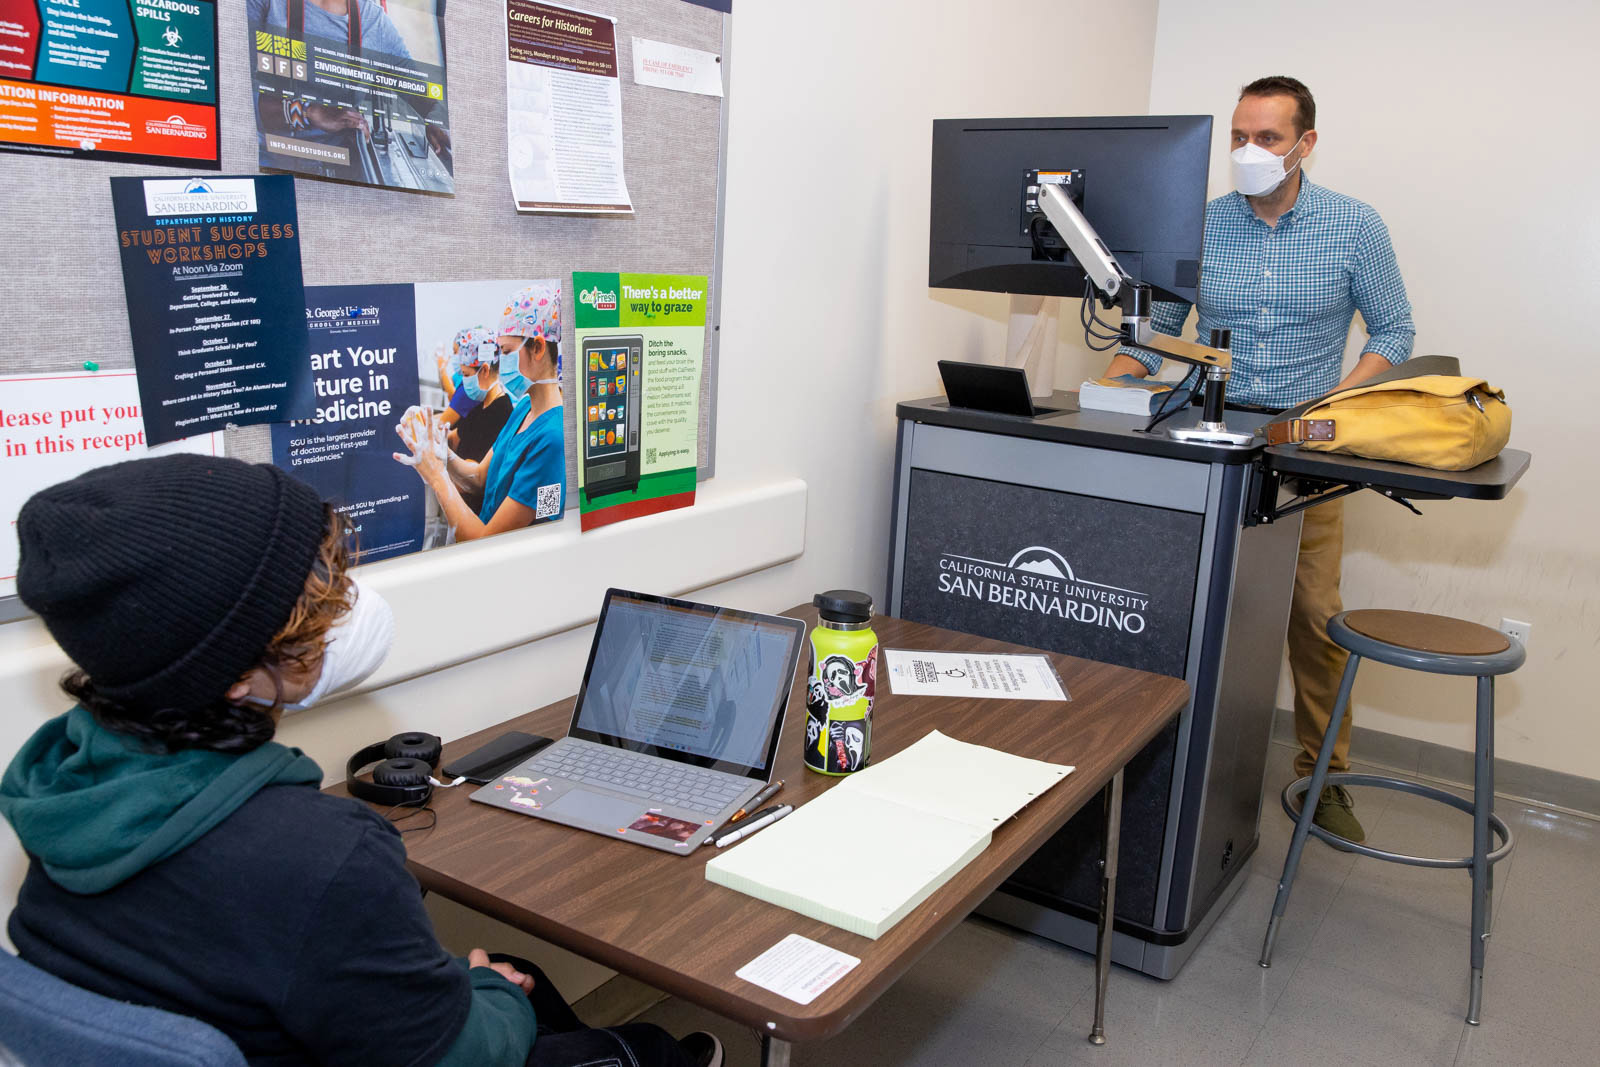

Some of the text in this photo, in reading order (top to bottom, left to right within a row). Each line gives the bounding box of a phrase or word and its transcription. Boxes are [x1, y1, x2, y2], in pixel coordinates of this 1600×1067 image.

[136, 0, 200, 15] HAZARDOUS
[137, 7, 170, 21] SPILLS
[509, 9, 540, 25] Careers
[541, 17, 554, 28] for
[555, 19, 593, 36] Historians
[314, 60, 426, 93] ENVIRONMENTAL STUDY ABROAD
[38, 90, 124, 110] INFORMATION
[145, 127, 207, 139] SAN BERNARDINO
[270, 141, 346, 160] INFO.FIELDSTUDIES.ORG
[154, 201, 248, 213] SAN BERNARDINO
[156, 217, 203, 226] DEPARTMENT
[121, 224, 294, 248] STUDENT SUCCESS
[146, 242, 268, 264] WORKSHOPS
[172, 262, 243, 275] At Noon Via Zoom
[622, 285, 702, 300] There's a better
[314, 307, 345, 319] George's
[346, 305, 380, 318] Uniersity
[631, 302, 693, 315] way to graze
[195, 315, 223, 324] September
[193, 324, 210, 332] College
[192, 346, 214, 355] Graduate
[311, 346, 397, 370] art Your
[174, 372, 194, 380] Crafting
[198, 368, 219, 377] Personal
[220, 365, 245, 374] Statement
[206, 382, 232, 391] November
[316, 370, 388, 396] ture in
[60, 404, 95, 428] put
[207, 404, 232, 413] November
[290, 397, 391, 427] edicine
[6, 431, 146, 457] in this recept
[290, 438, 306, 447] SGU
[326, 433, 349, 443] largest
[350, 429, 376, 439] provider
[291, 448, 299, 456] of
[300, 445, 326, 456] doctors
[340, 440, 368, 450] first-year
[338, 503, 355, 512] about
[356, 501, 368, 509] SGU
[376, 495, 402, 505] attending
[939, 559, 1148, 611] CALIFORNIA STATE UNIVERSITY
[938, 573, 1145, 634] SAN BERNARDINO
